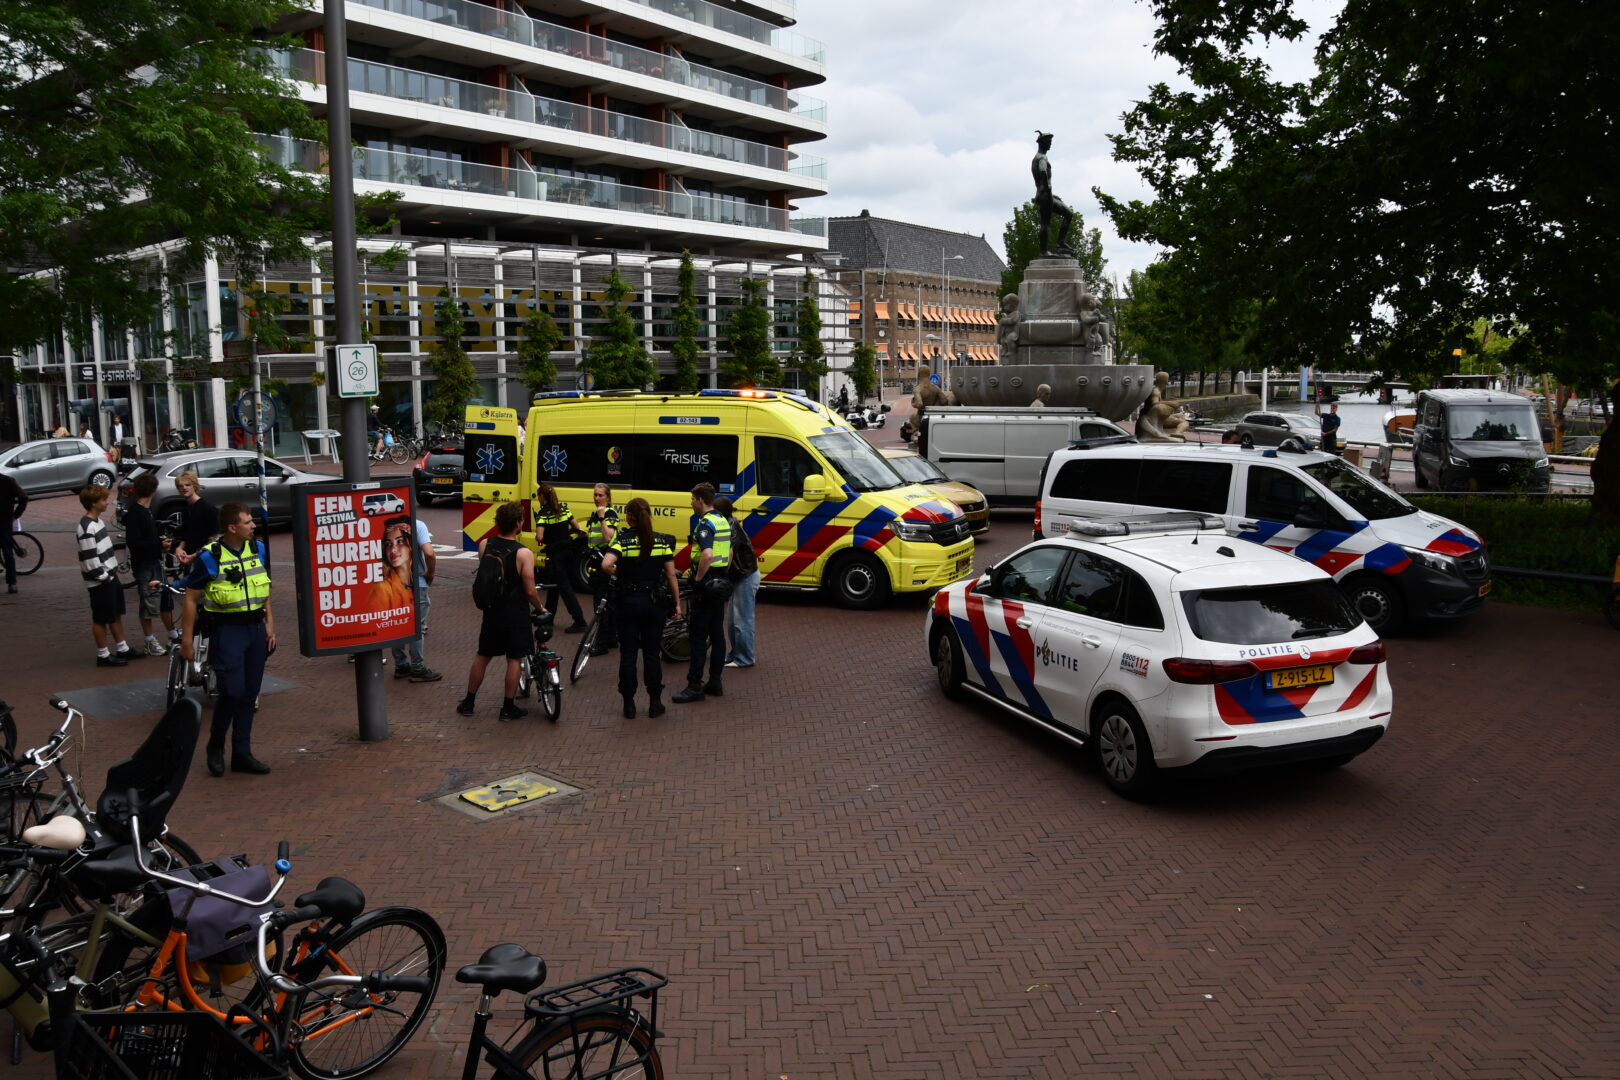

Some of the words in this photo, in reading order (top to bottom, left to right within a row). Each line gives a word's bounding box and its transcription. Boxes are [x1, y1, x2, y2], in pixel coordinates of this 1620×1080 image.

[101, 369, 126, 382] G-STAR
[125, 369, 141, 381] RAW
[352, 366, 364, 376] 26
[665, 449, 710, 465] FRISIUS
[314, 495, 353, 515] EEN
[317, 511, 356, 526] FESTIVAL
[316, 517, 371, 541] AUTO
[316, 539, 383, 564] HUREN
[317, 565, 358, 588] DOE
[362, 562, 384, 584] JE
[319, 588, 352, 611] BIJ
[320, 606, 411, 628] bourguignon
[376, 616, 410, 629] verhuur
[1036, 644, 1079, 672] POLITIE
[1122, 652, 1136, 662] 0900
[1239, 644, 1293, 658] POLITIE
[1135, 656, 1150, 671] 112
[1277, 667, 1326, 686] Z-915-LZ
